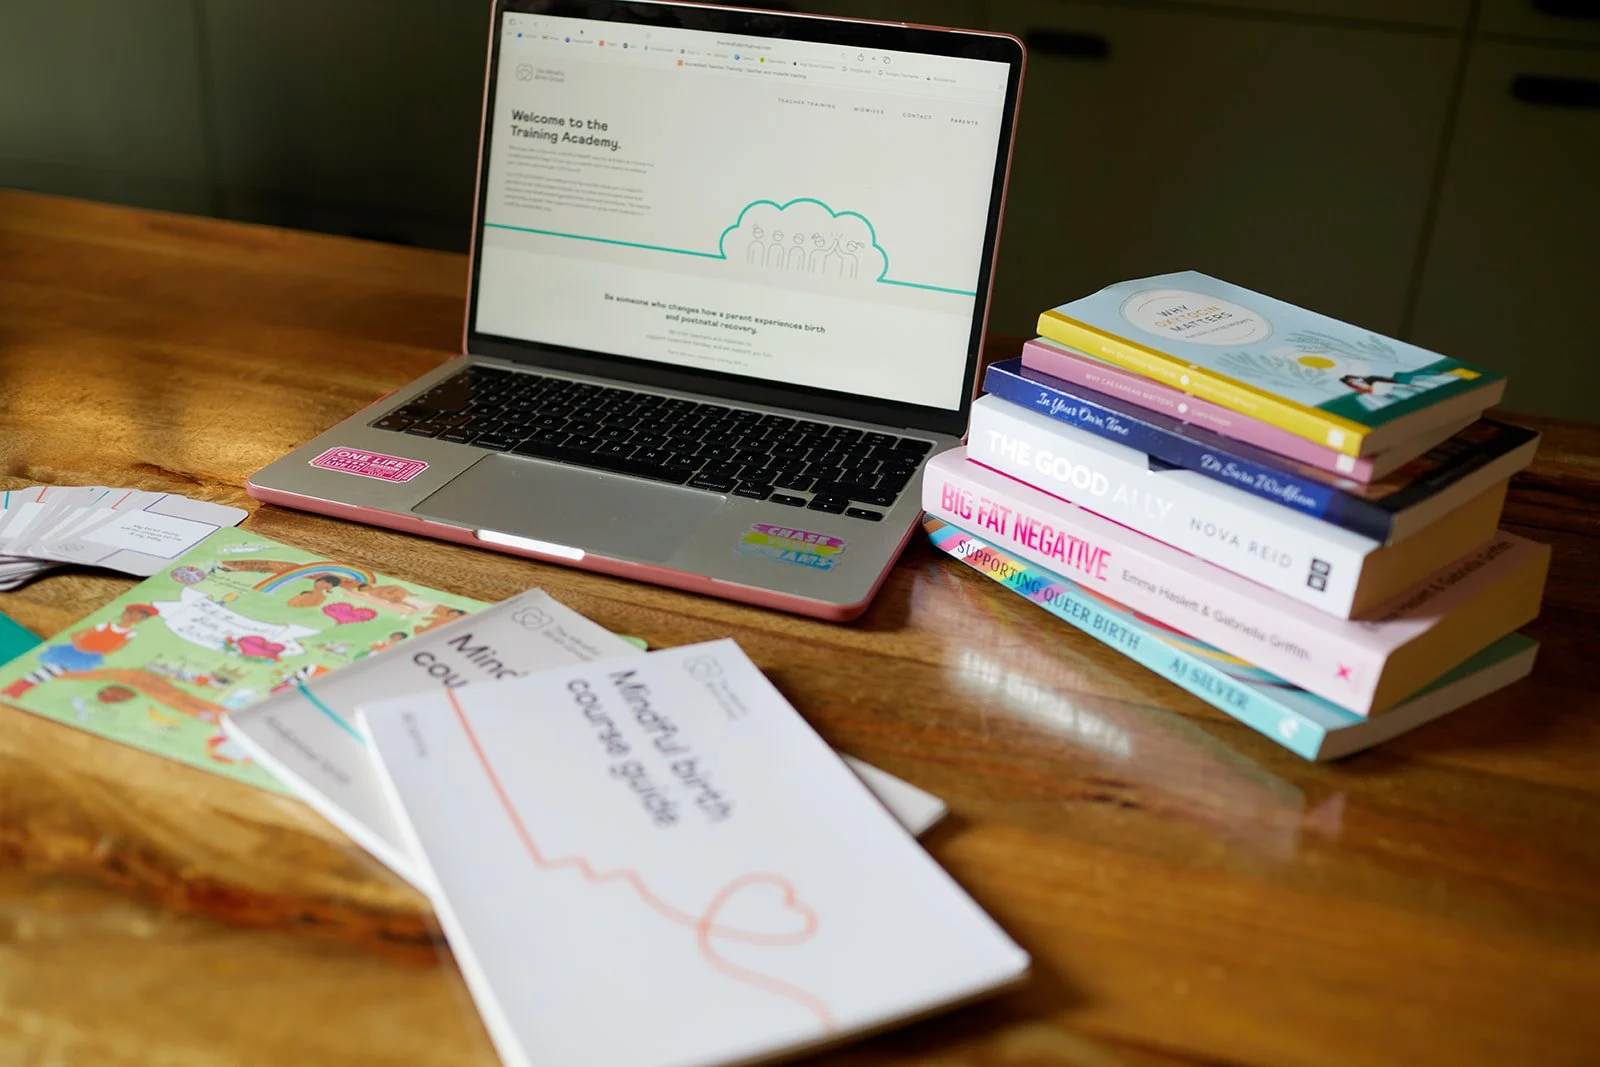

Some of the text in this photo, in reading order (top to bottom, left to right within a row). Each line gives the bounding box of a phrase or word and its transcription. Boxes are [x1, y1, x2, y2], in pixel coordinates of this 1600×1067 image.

[807, 101, 836, 109] TRAINING
[853, 107, 884, 115] MIDWIVES
[902, 112, 932, 120] CONTACT
[512, 110, 608, 131] Welcome to the
[950, 118, 979, 126] PARENTS
[510, 125, 621, 152] Training Academy.
[604, 293, 614, 301] Be
[616, 296, 648, 306] someone
[651, 300, 666, 309] who
[668, 303, 700, 315] changes
[702, 308, 717, 317] how
[726, 312, 752, 323] parent
[755, 316, 803, 330] experiences
[804, 324, 826, 334] birth
[1154, 304, 1222, 328] OXYTOCIN
[1156, 304, 1189, 318] WHY
[666, 312, 758, 335] and postnatal recovery.
[1170, 312, 1233, 333] MATTERS
[1086, 373, 1100, 382] WHY
[1036, 392, 1050, 407] In
[1050, 398, 1078, 416] Your
[1079, 407, 1104, 428] Own
[1106, 416, 1130, 436] Time
[1200, 454, 1222, 472] Dr
[337, 451, 408, 469] ONE LIFE
[988, 430, 1293, 569] THE GOOD ALLY NOVA REID
[768, 528, 831, 546] CHASE
[941, 480, 973, 520] BIG
[977, 496, 1012, 536] FAT
[1012, 512, 1112, 582] NEGATIVE
[1121, 569, 1156, 593] Emma
[1158, 584, 1200, 613] Haslett
[1202, 605, 1210, 616] &
[1269, 634, 1312, 661] Griffin
[957, 539, 1250, 712] SUPPORTING QUEER BIRTH AJ SILVER
[566, 677, 680, 828] course guide
[608, 668, 692, 757] Mindful
[671, 757, 732, 822] birth
